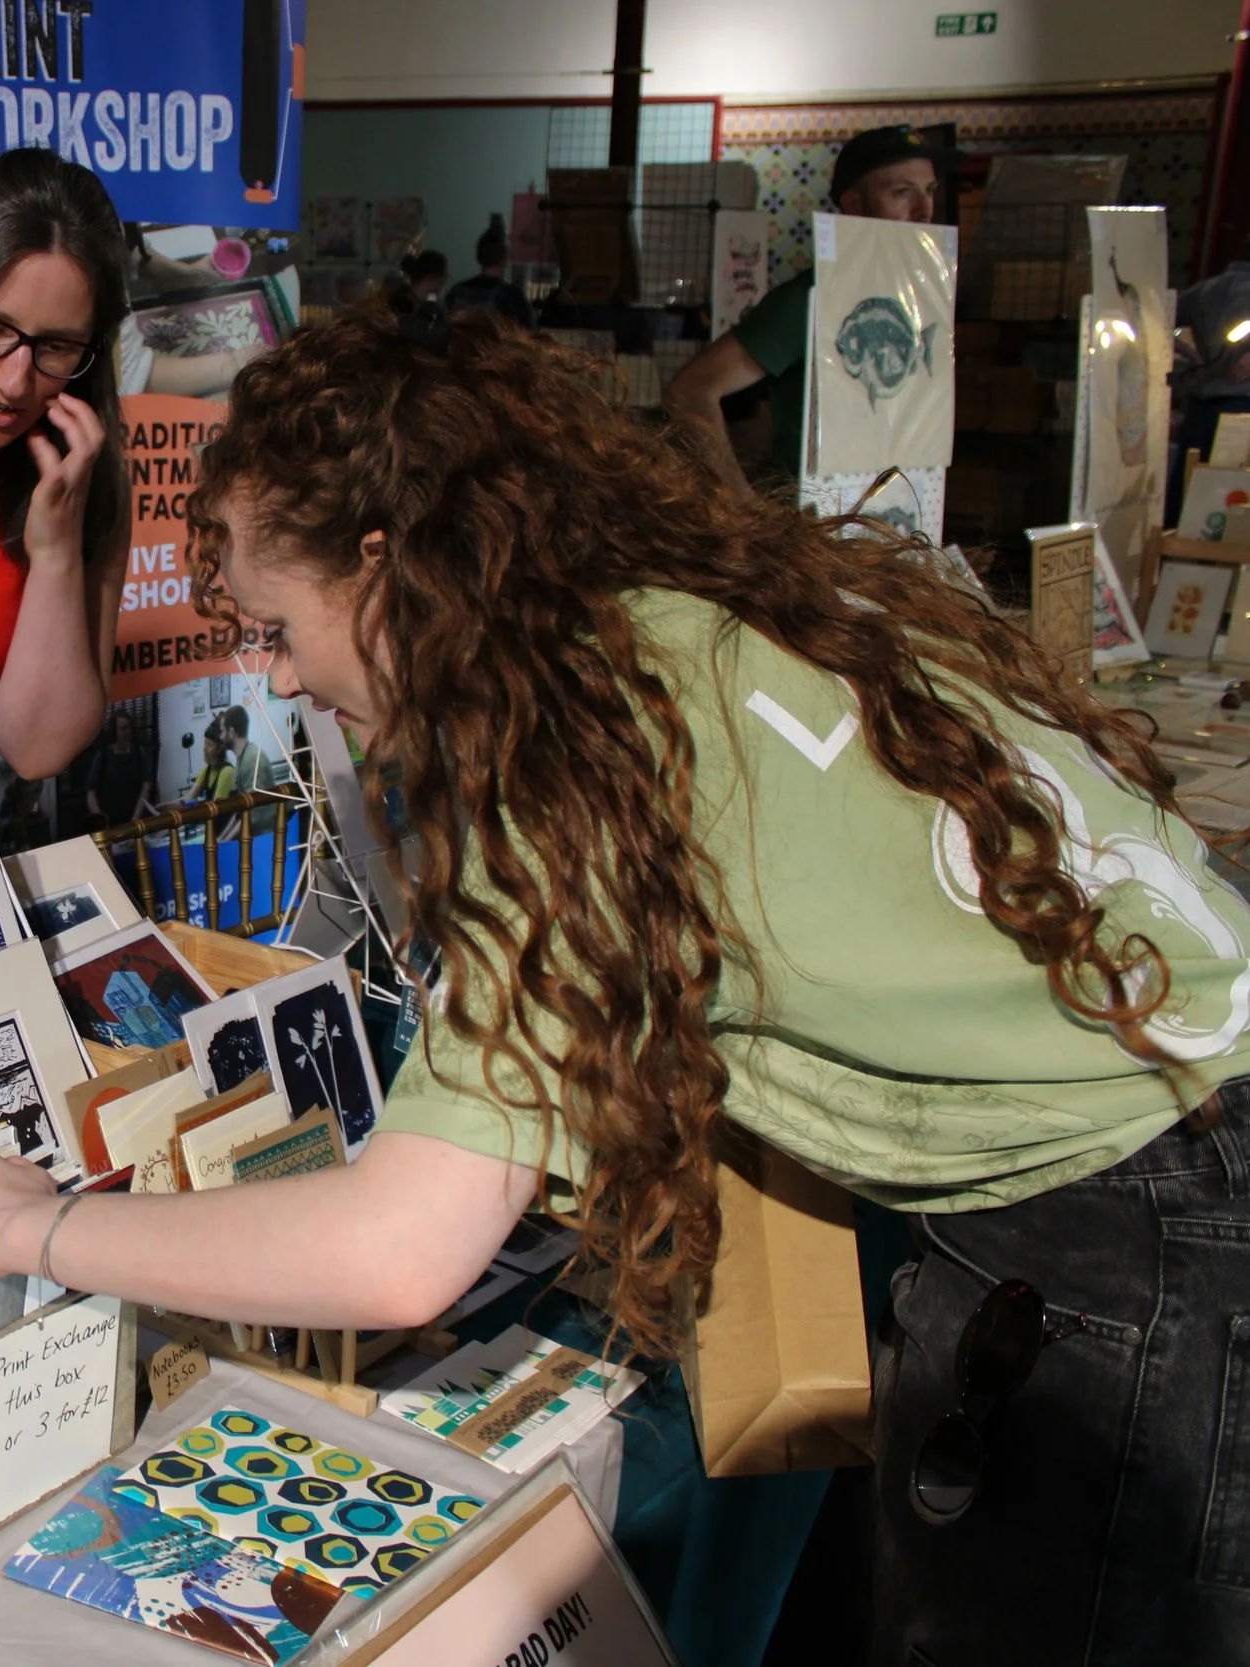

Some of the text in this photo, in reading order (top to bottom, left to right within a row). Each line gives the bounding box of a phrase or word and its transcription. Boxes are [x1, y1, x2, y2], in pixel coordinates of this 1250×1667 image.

[41, 1315, 116, 1361] Exchange
[152, 1335, 201, 1381] Notebooks
[4, 1383, 42, 1414] this
[54, 1365, 86, 1388] box
[166, 1362, 198, 1398] £3.50
[4, 1430, 23, 1451] or
[35, 1411, 50, 1438] 3
[55, 1402, 78, 1431] for
[81, 1385, 110, 1419] £12
[543, 1591, 593, 1654] DAY!
